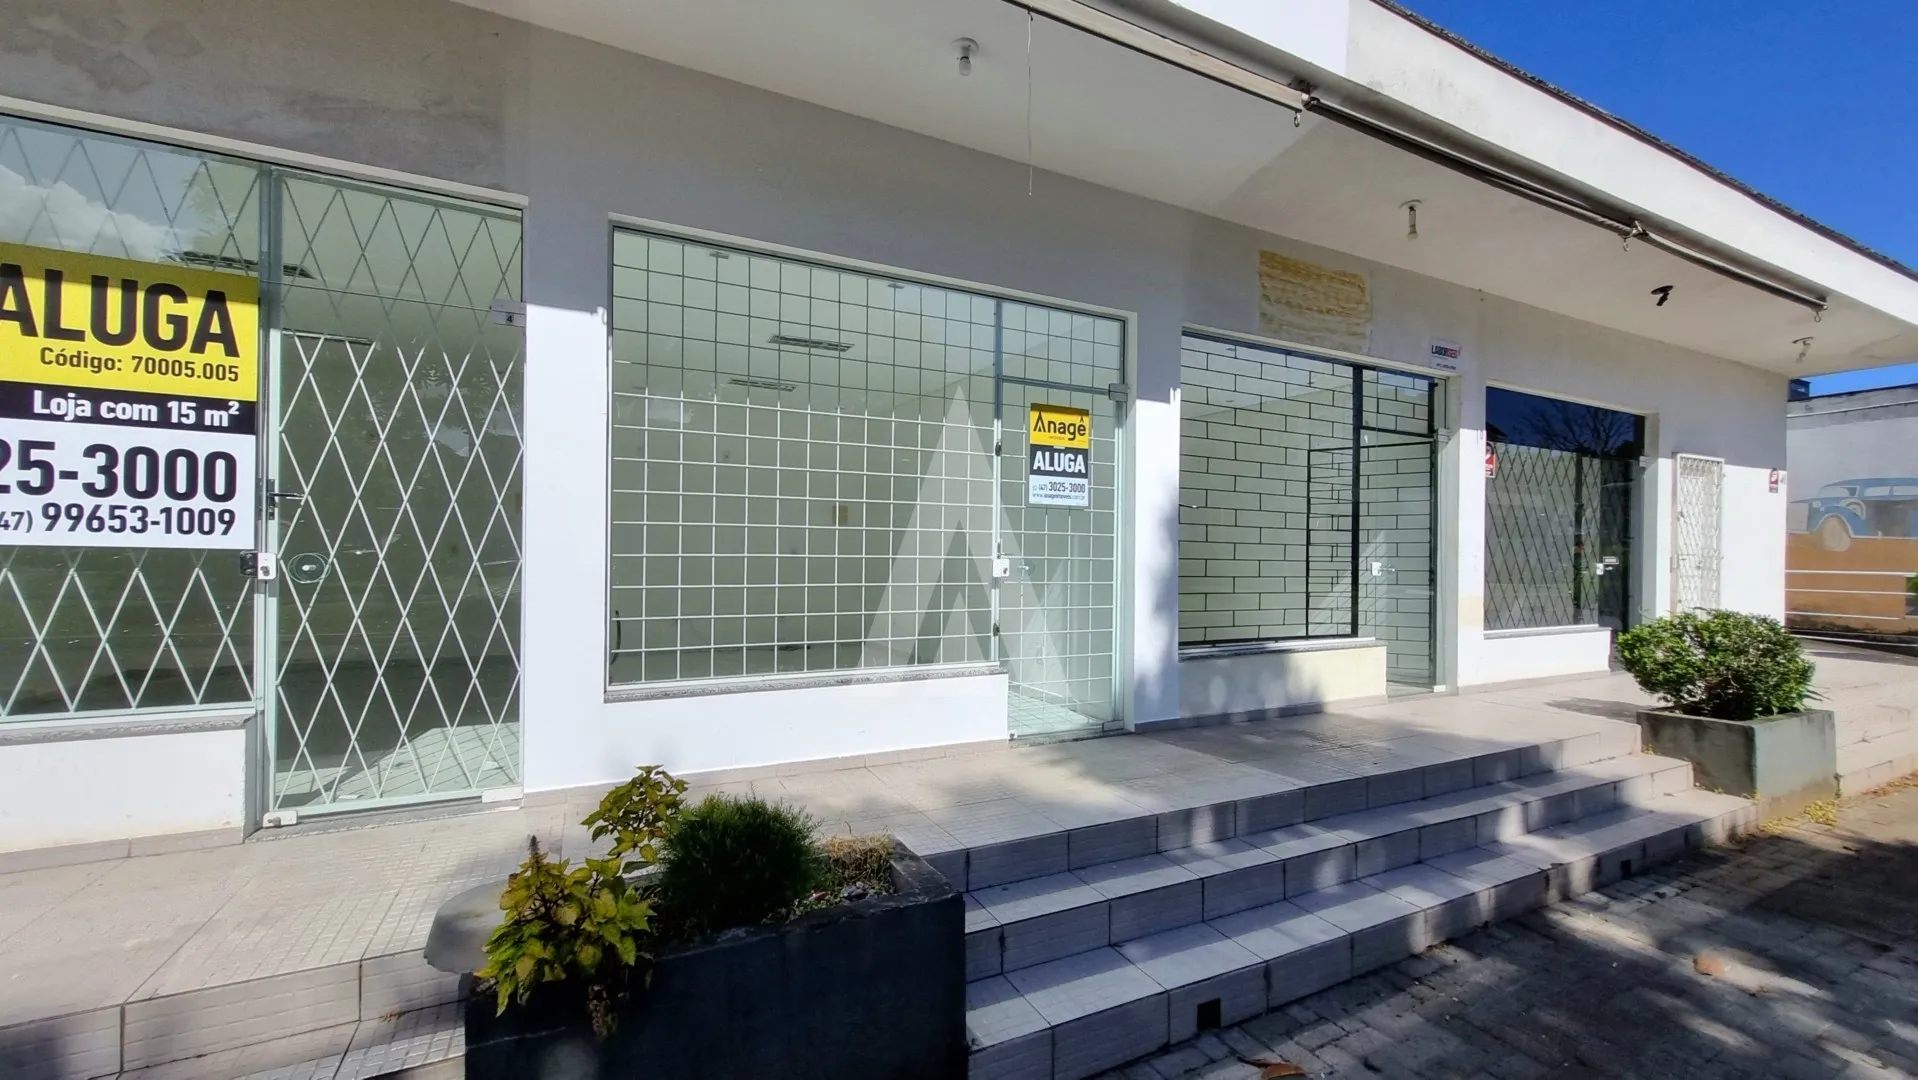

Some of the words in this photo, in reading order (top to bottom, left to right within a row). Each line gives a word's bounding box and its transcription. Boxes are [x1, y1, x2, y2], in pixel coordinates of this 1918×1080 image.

[0, 263, 240, 358] ALUGA
[40, 347, 122, 374] Código:
[131, 355, 239, 382] 70005.005
[33, 389, 92, 422] Loja
[100, 401, 158, 422] com
[167, 401, 196, 425] 15
[204, 400, 240, 427] m²
[1033, 450, 1086, 474] ALUGA
[1048, 481, 1086, 494] 3025-3000
[41, 502, 236, 536] 99653-1009
